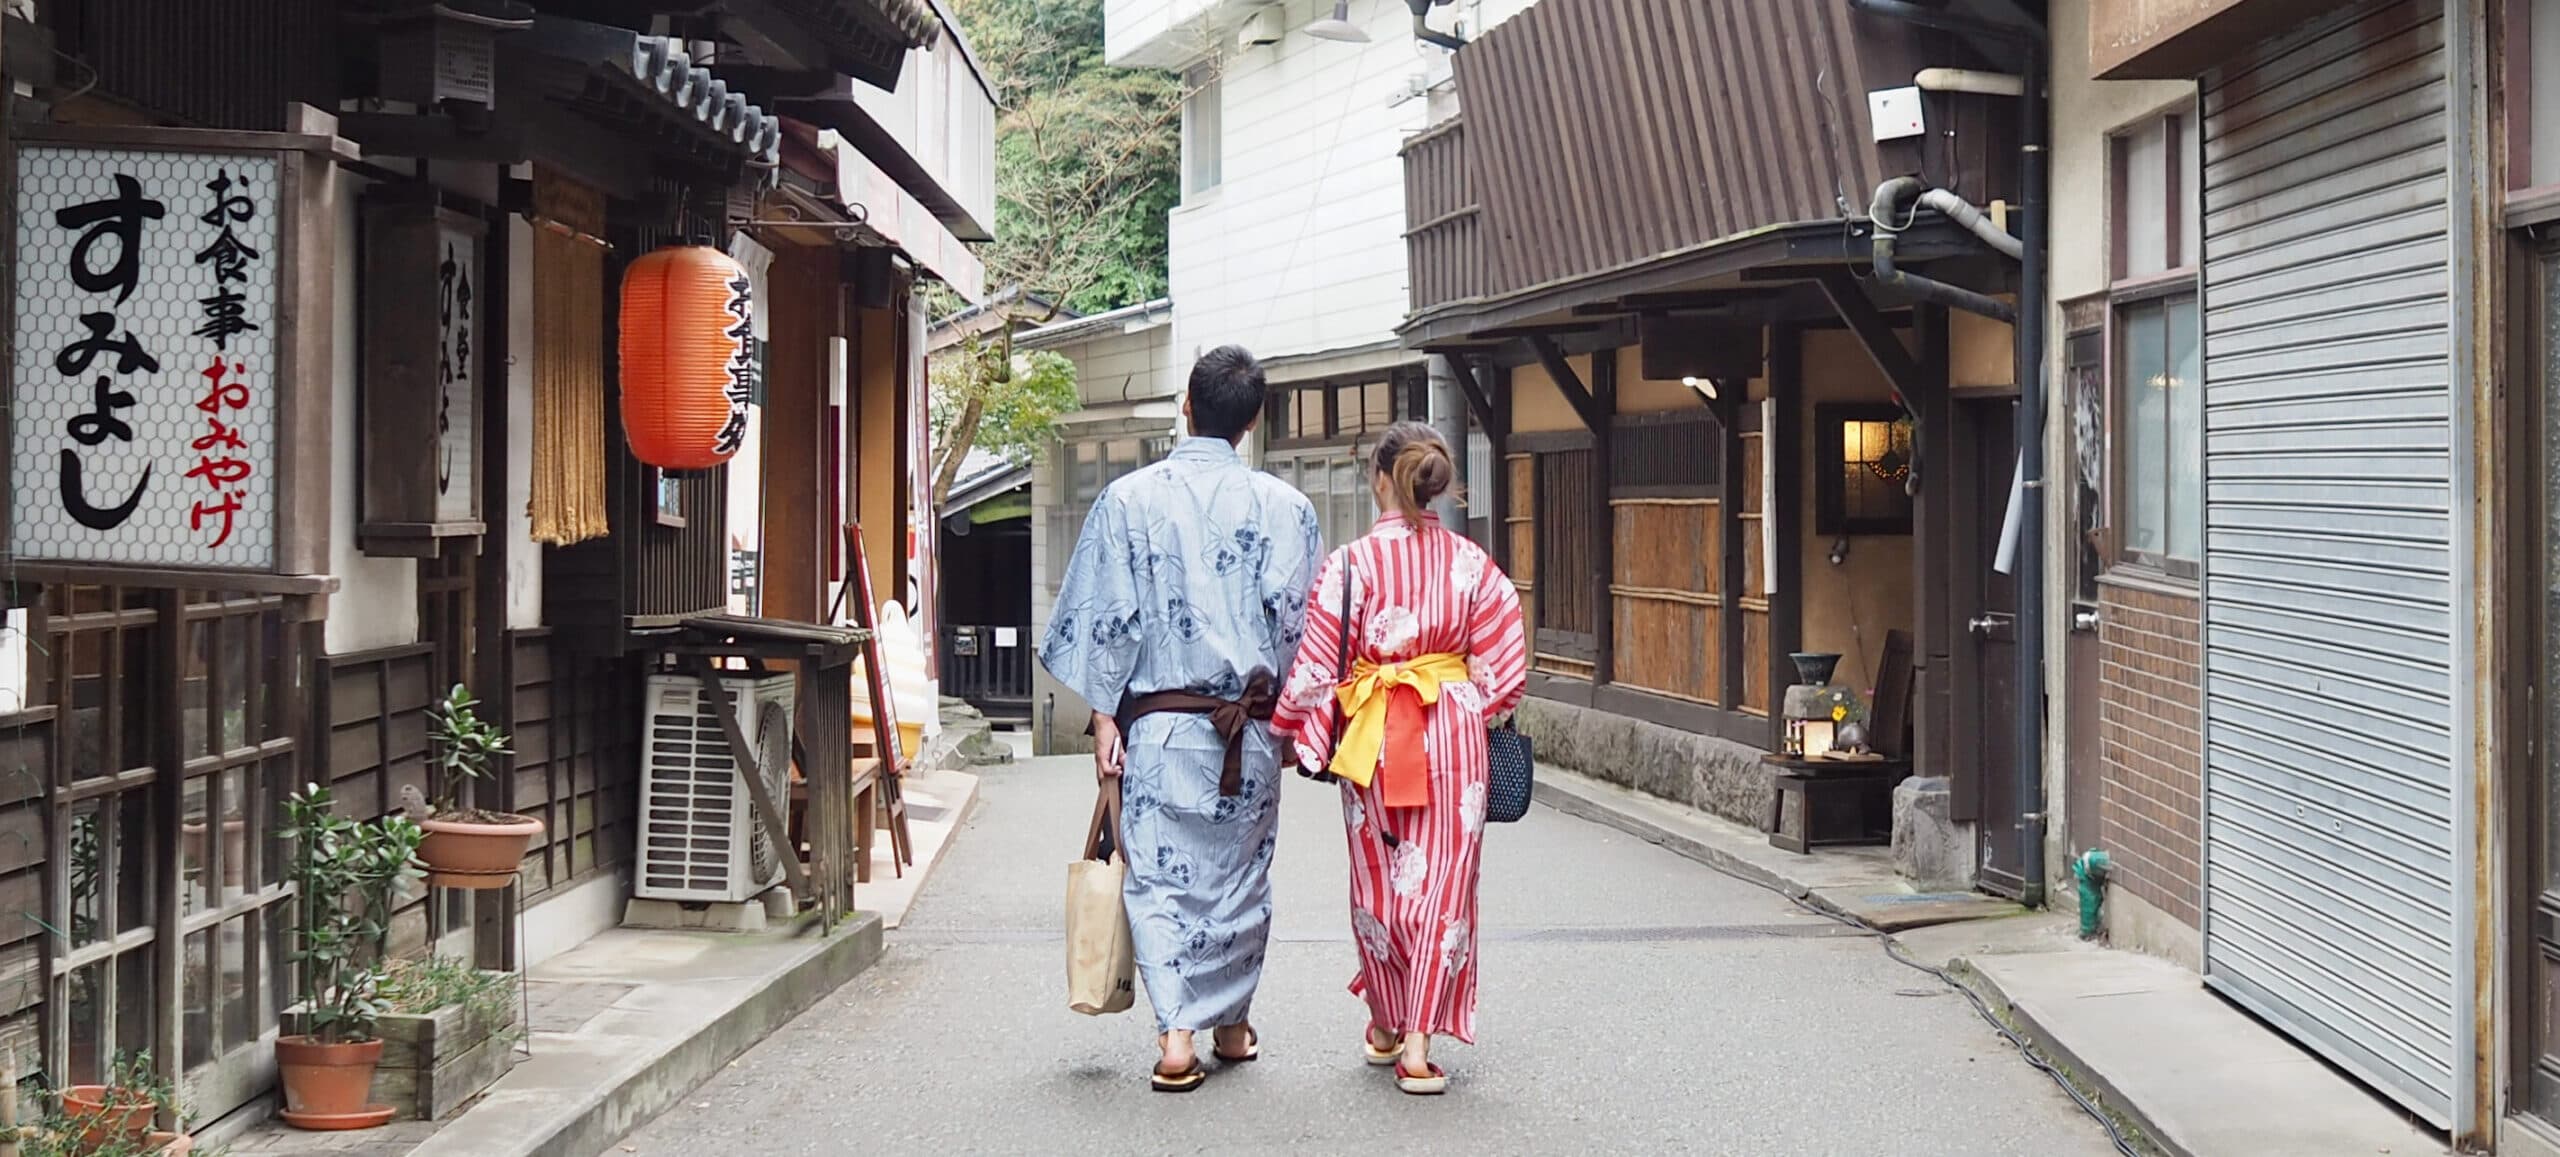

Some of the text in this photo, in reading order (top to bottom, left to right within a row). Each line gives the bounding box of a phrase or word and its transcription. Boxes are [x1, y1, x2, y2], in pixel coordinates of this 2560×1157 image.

[55, 173, 165, 530] すみよし
[183, 168, 260, 549] お食事 おみやげ
[439, 241, 457, 497] すみよし
